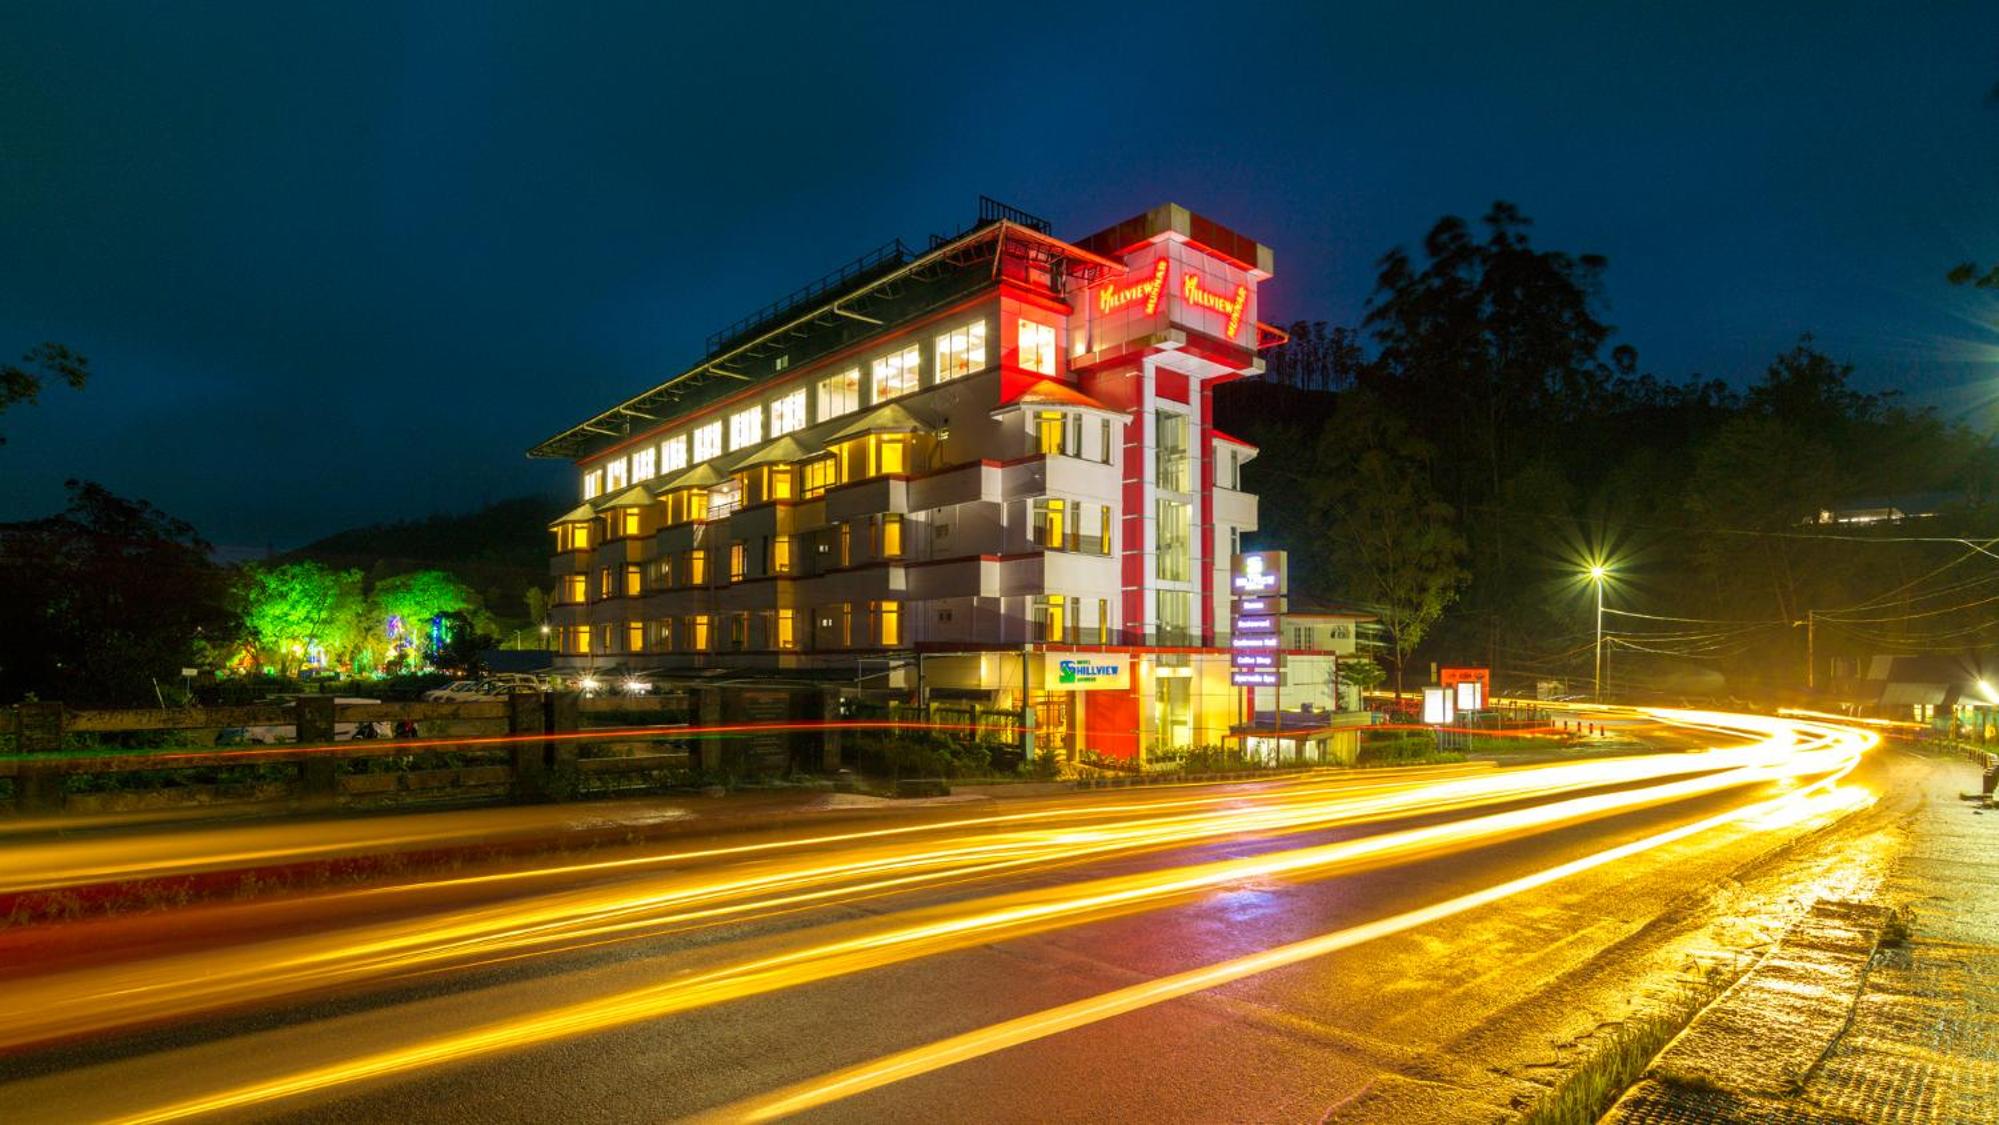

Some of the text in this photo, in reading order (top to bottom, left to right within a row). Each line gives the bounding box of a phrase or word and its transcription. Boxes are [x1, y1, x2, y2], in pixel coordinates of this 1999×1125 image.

[1100, 284, 1154, 314] HILLVIEW
[1184, 274, 1233, 314] HILLVIEW
[1076, 666, 1119, 675] HILLVIEW
